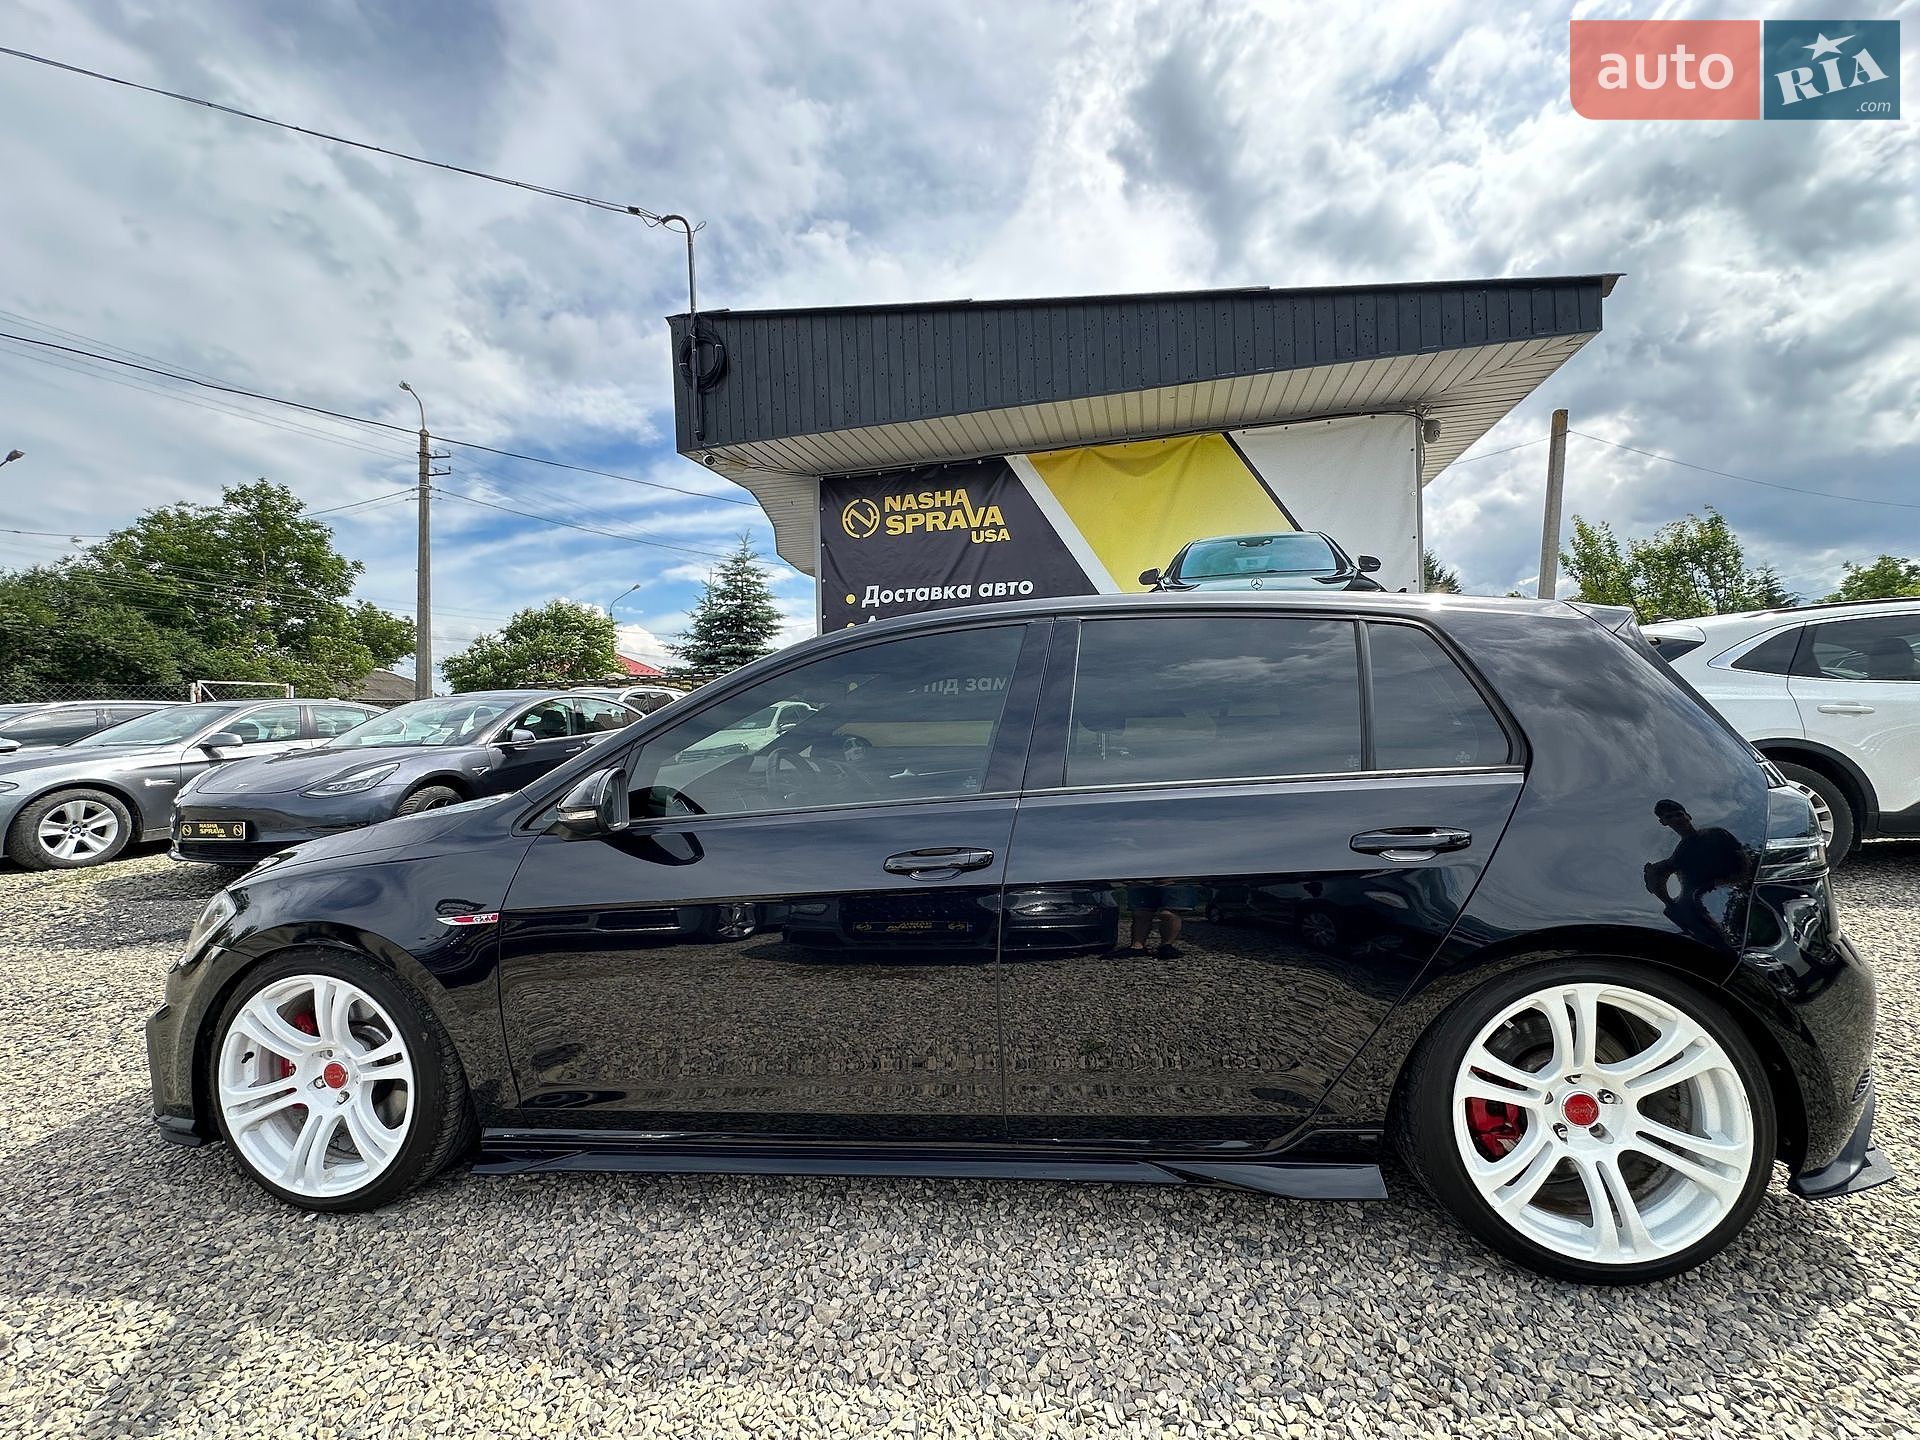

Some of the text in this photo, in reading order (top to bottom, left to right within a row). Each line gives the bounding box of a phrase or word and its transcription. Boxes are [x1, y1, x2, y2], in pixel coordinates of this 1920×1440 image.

[884, 489, 969, 513] NASHA
[885, 505, 1005, 536] SPRAVA
[971, 528, 1011, 544] USA
[861, 580, 1034, 608] Доставка авто
